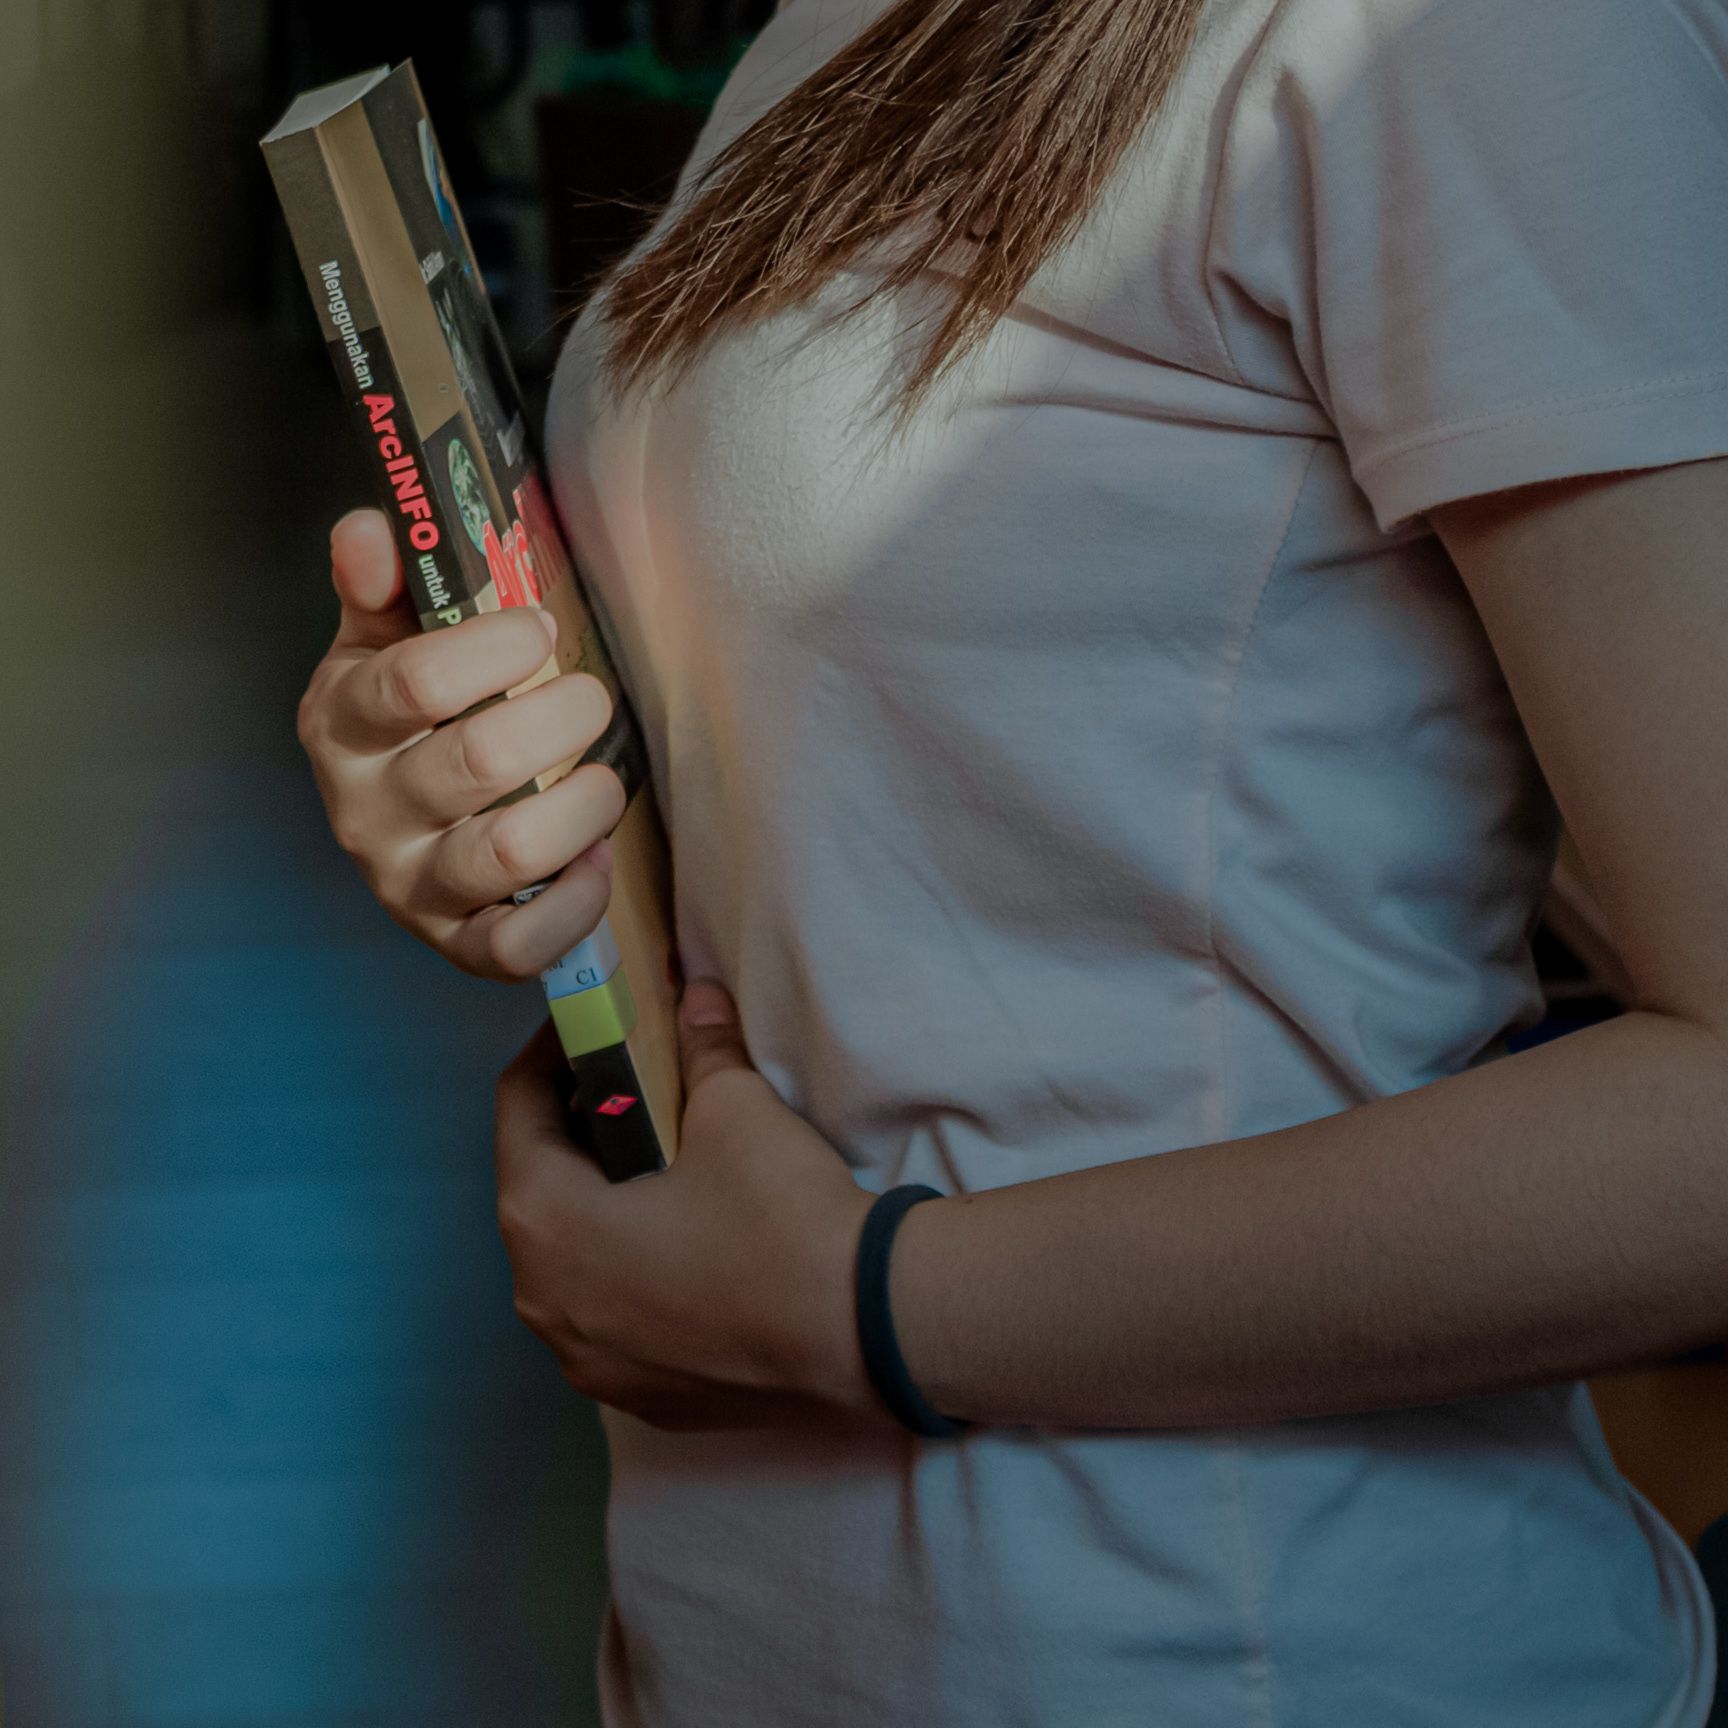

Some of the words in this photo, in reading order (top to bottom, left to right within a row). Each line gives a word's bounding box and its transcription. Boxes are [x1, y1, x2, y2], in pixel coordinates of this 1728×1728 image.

[319, 260, 375, 389] Menggunakan
[362, 393, 441, 552] ArcINFO
[418, 554, 452, 609] untuk
